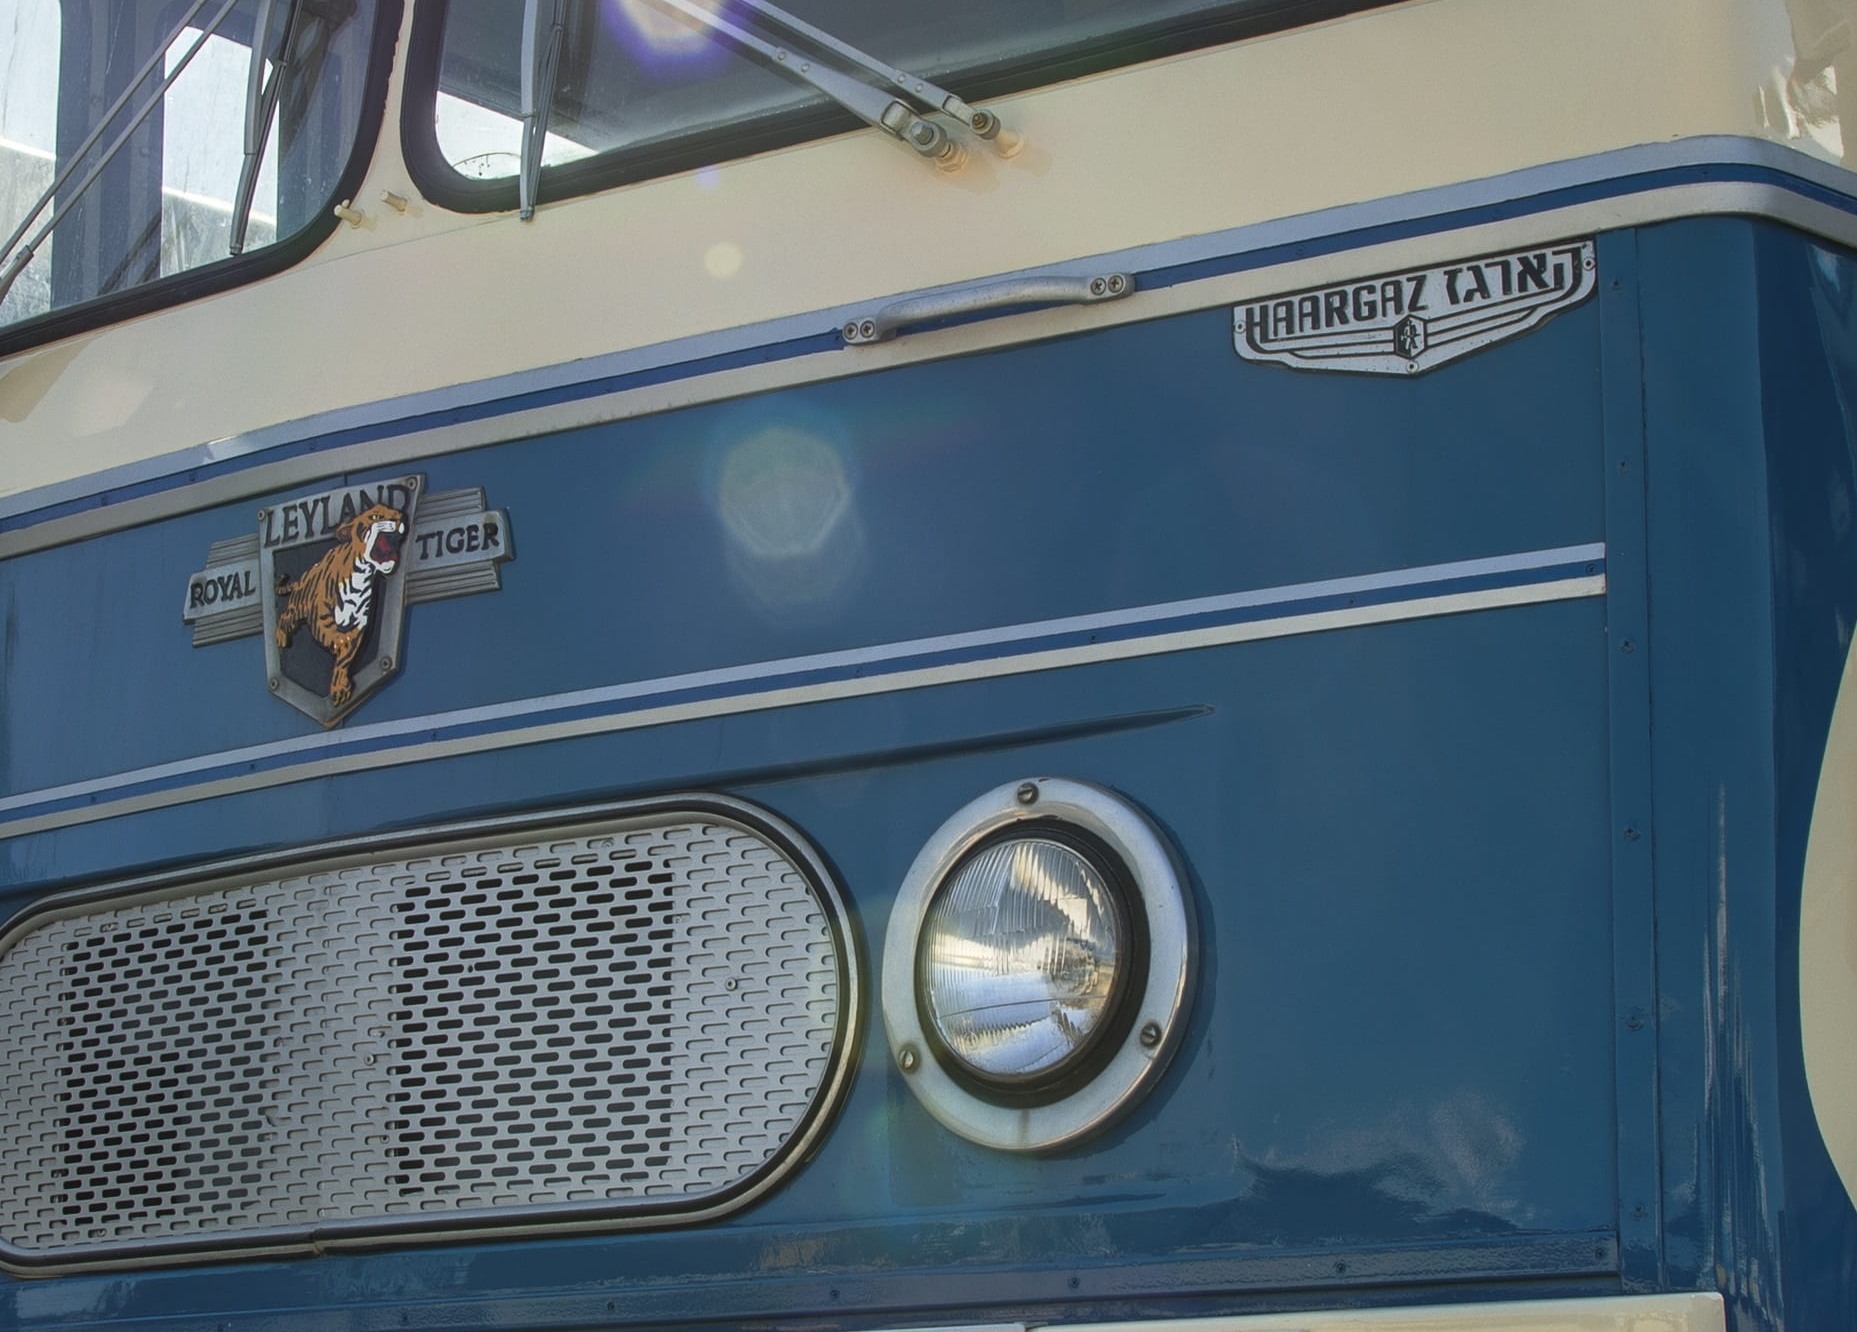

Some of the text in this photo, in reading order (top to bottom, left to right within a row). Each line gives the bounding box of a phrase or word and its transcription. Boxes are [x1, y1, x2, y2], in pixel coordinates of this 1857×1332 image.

[1245, 245, 1583, 345] HAARGAZ הארגז
[415, 522, 500, 561] TIGER
[189, 570, 256, 610] ROYAL
